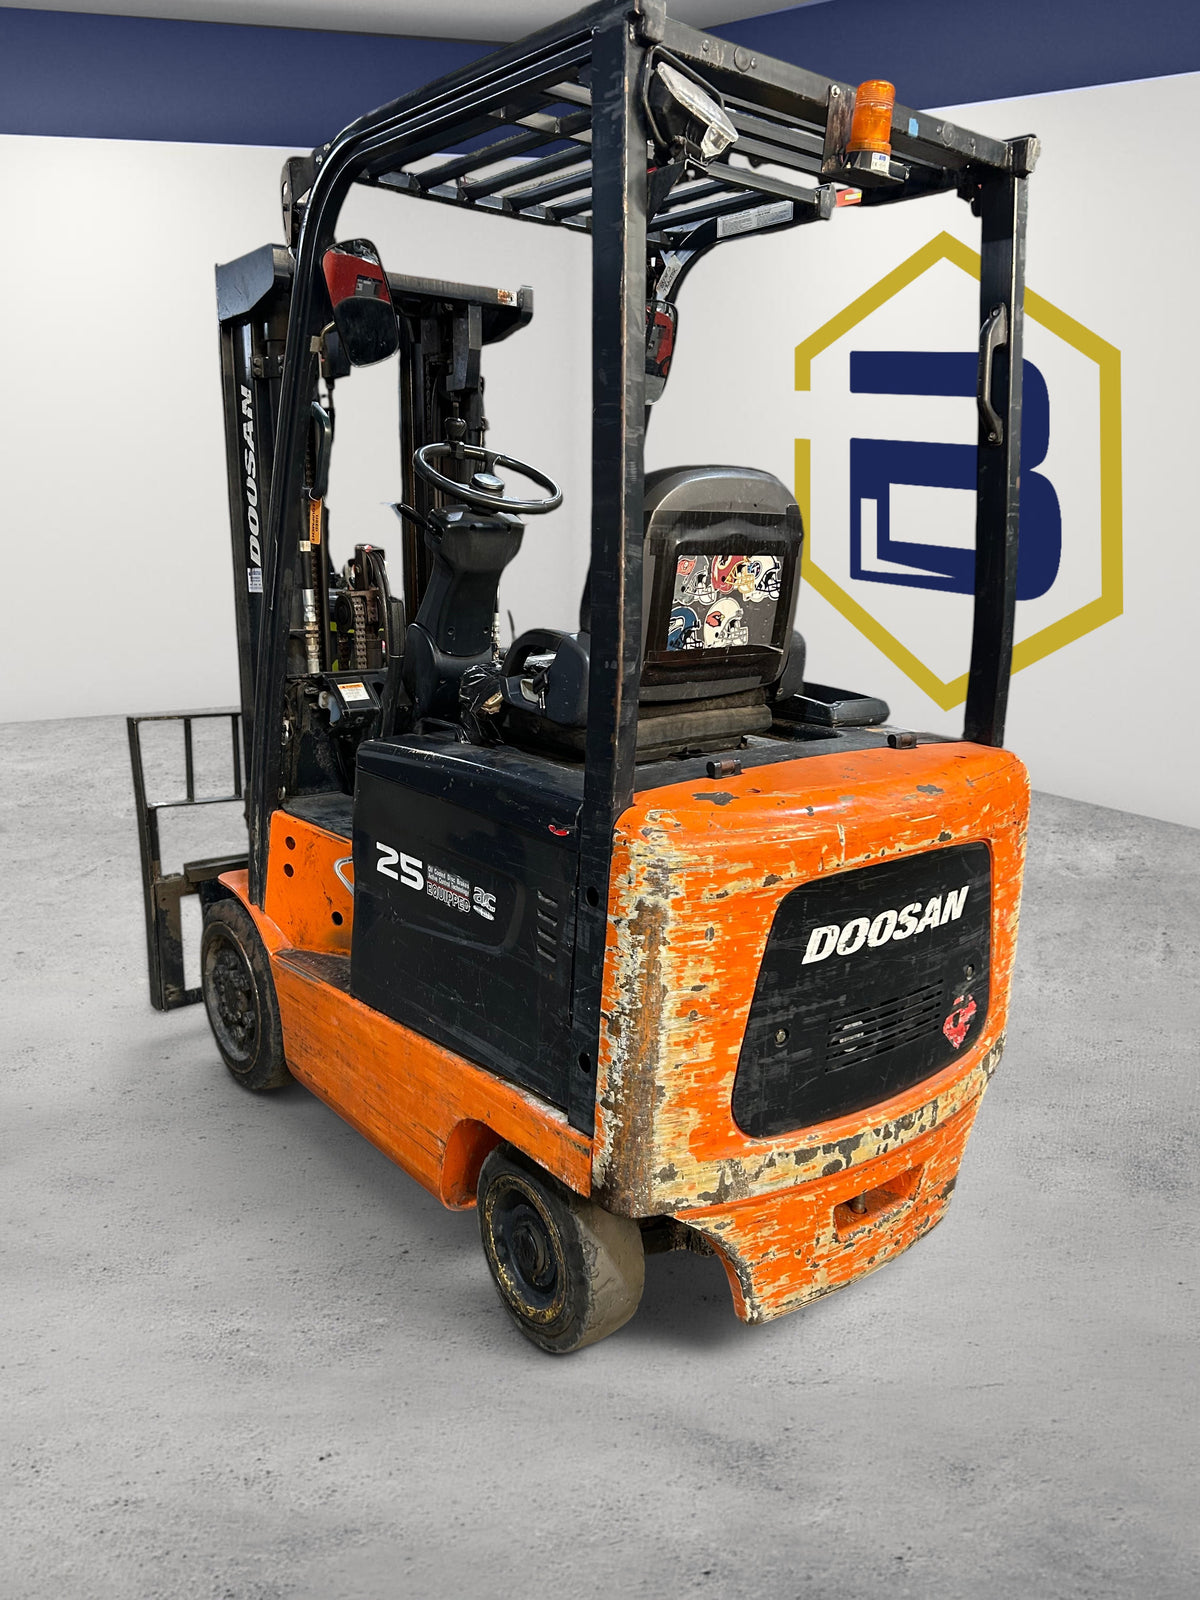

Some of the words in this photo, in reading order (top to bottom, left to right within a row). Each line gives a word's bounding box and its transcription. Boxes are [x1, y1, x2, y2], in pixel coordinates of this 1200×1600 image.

[240, 384, 261, 567] DOOSAN
[376, 841, 424, 890] 25
[426, 881, 471, 912] EQUIPPED
[801, 886, 970, 965] DOOSAN
